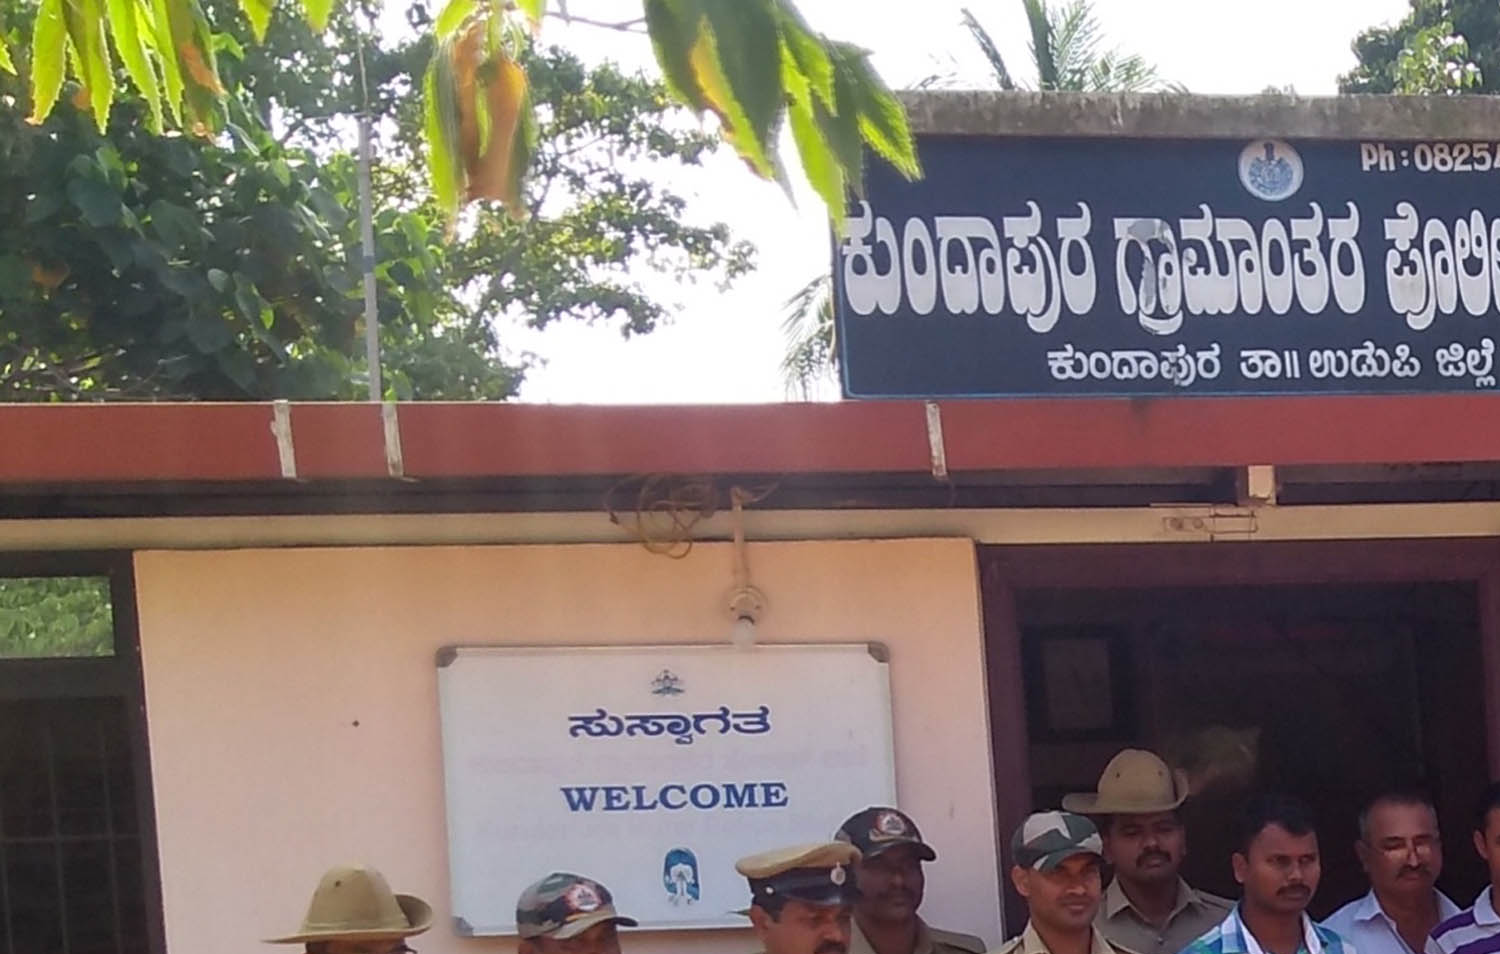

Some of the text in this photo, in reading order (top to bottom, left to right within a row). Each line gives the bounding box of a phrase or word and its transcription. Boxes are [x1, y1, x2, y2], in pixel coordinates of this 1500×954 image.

[842, 199, 1097, 333] ಕುಂದಾಪುರ
[1113, 201, 1366, 335] ಗ್ರಾಮಾಂತರ
[1047, 343, 1221, 387] ಕುಂದಾಪುರ
[1308, 340, 1421, 379] ಉಡುಪಿ
[567, 705, 772, 745] ಸುಸ್ವಾಗತ
[560, 782, 789, 812] WELCOME
